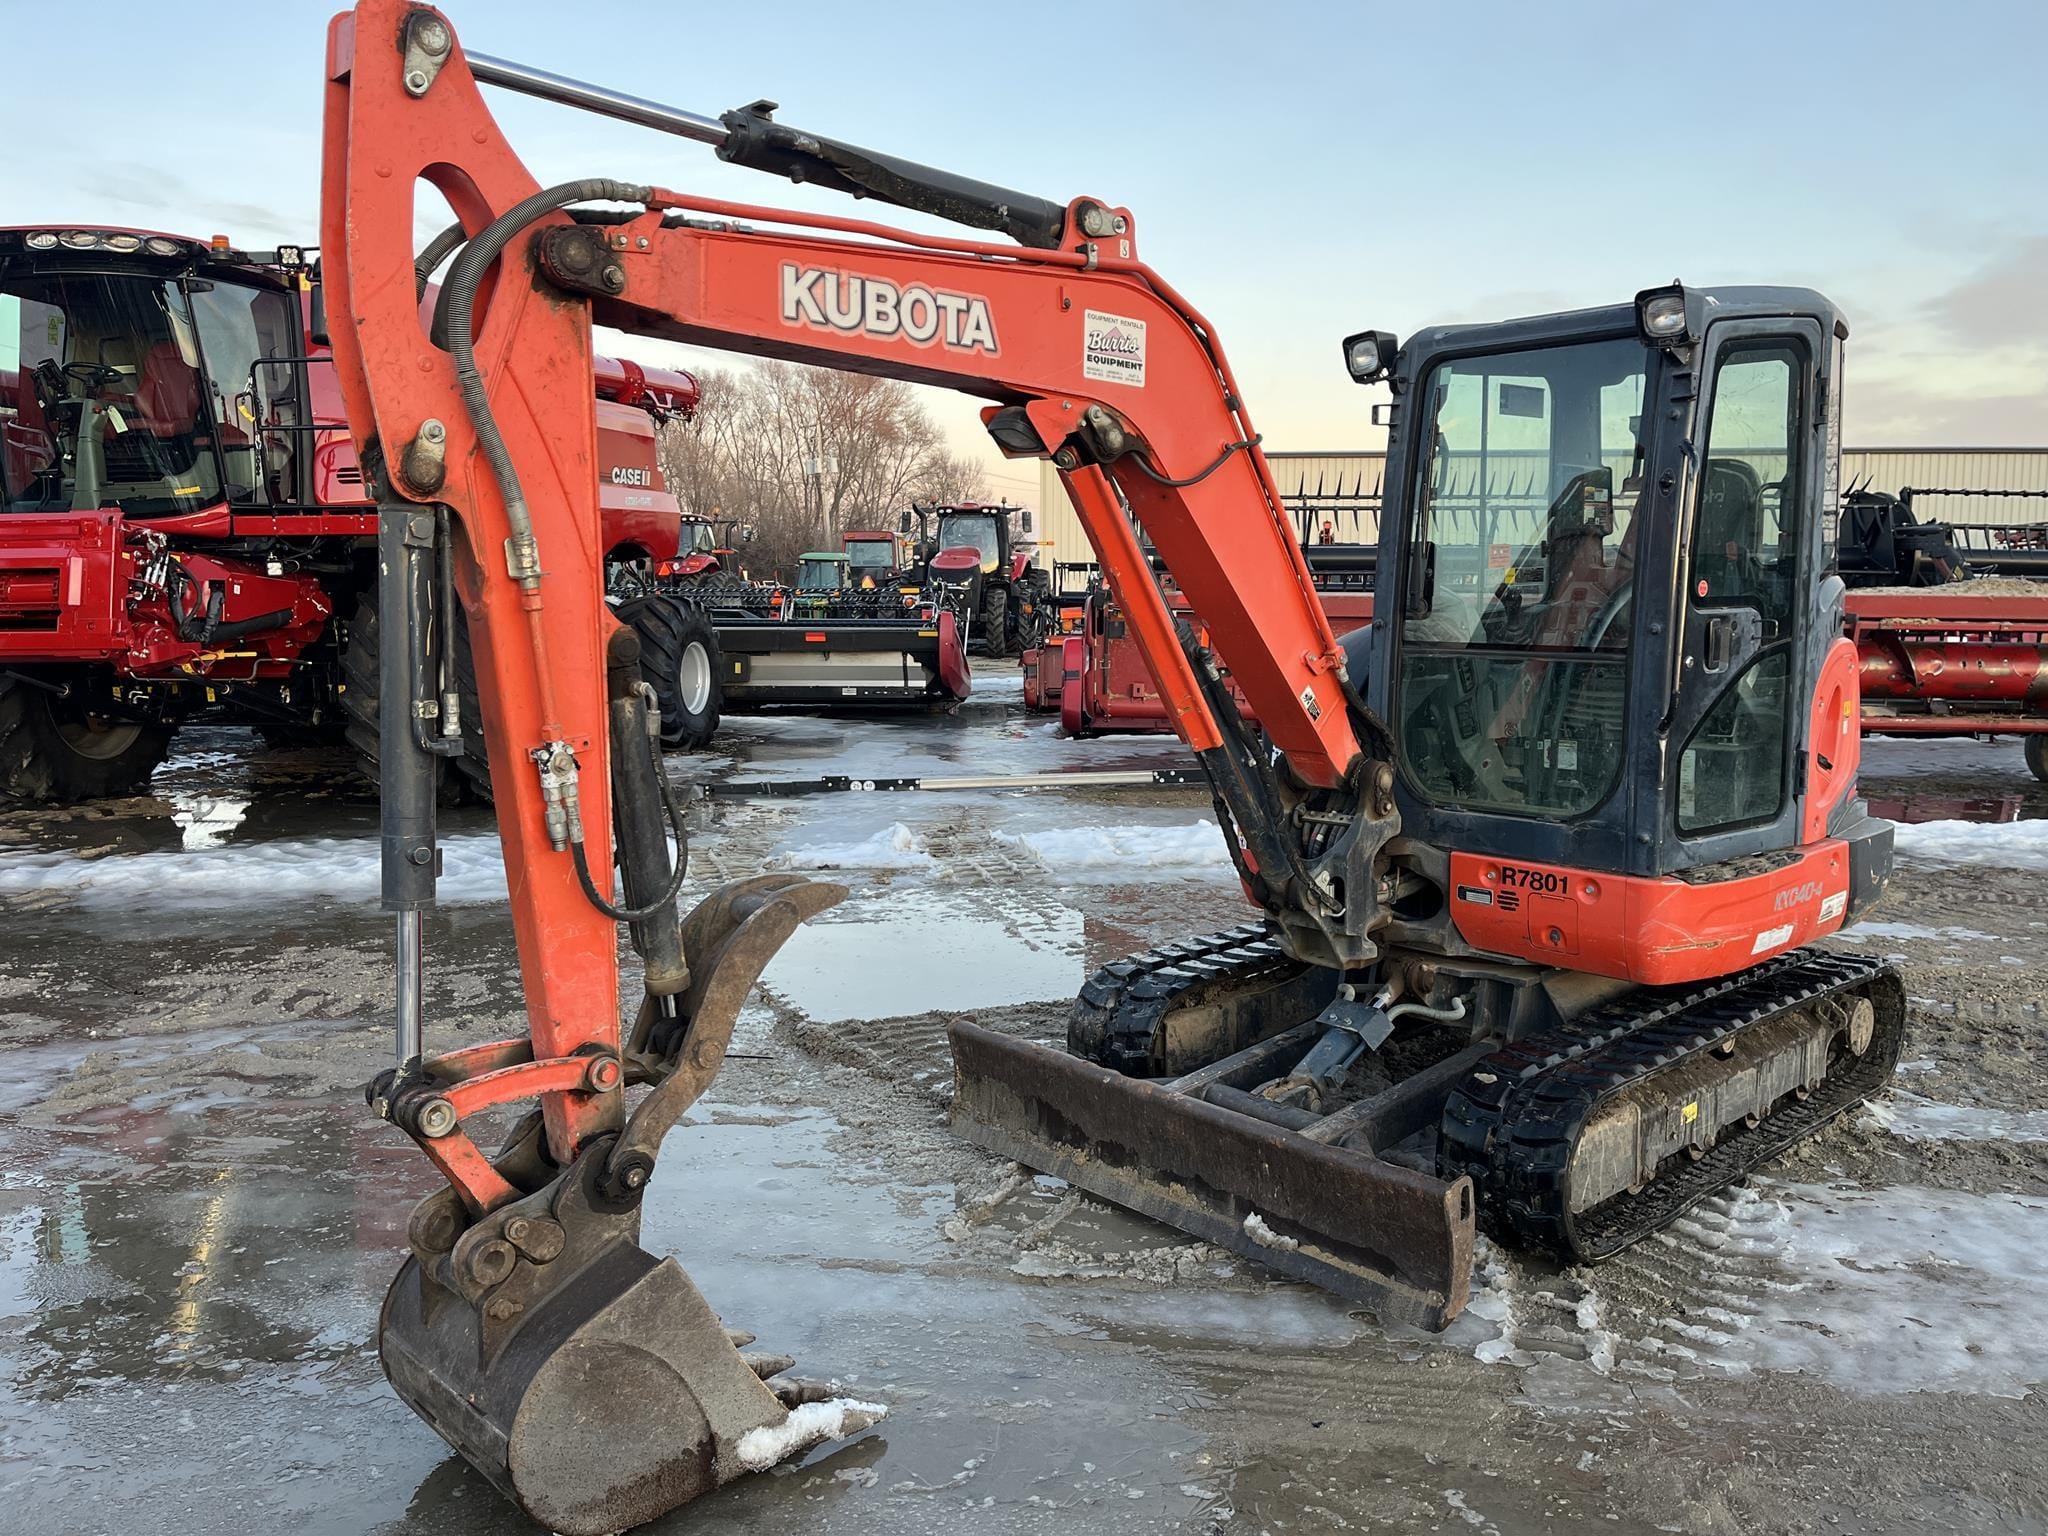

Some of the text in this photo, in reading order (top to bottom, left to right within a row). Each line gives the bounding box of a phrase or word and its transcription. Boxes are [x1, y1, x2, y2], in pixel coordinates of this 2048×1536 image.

[781, 264, 998, 352] KUBOTA
[1087, 312, 1144, 330] EQUIPMENT RENTALS
[1088, 330, 1140, 354] Burris
[1086, 353, 1144, 371] EQUIPMENT
[611, 466, 641, 486] CASE
[1501, 866, 1568, 894] R7801
